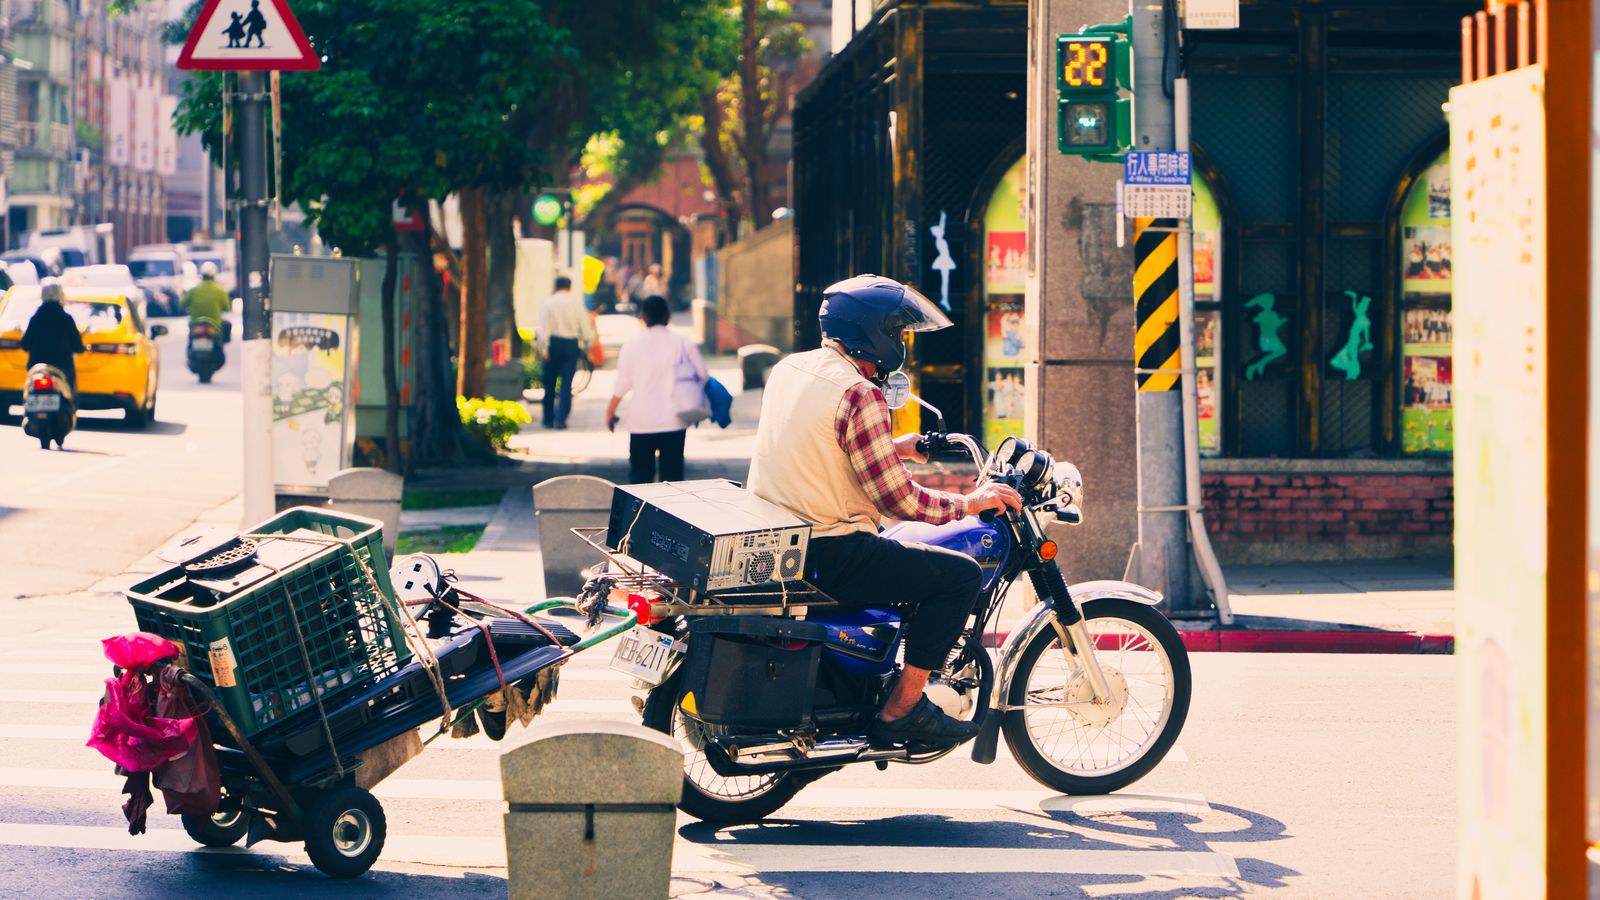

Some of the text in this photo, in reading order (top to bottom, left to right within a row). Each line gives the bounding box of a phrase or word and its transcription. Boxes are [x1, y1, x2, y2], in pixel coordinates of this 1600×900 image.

[1065, 43, 1106, 86] 22
[1127, 153, 1189, 176] 行人專用時相
[1153, 176, 1187, 184] Crossing
